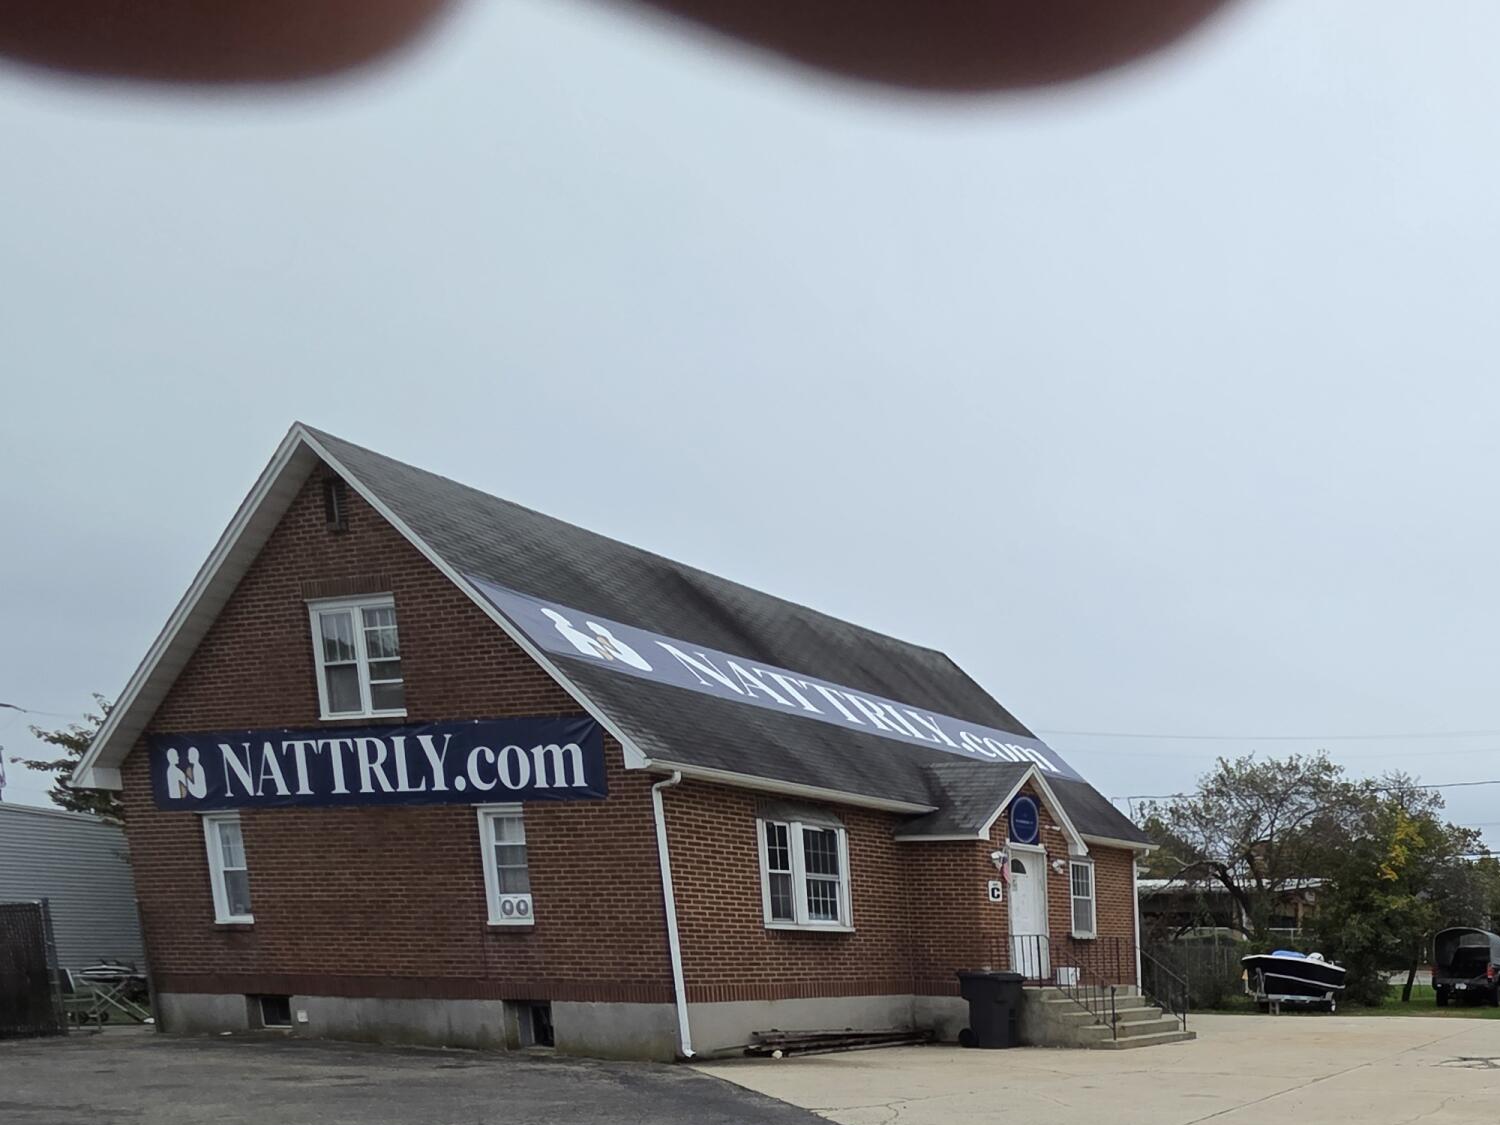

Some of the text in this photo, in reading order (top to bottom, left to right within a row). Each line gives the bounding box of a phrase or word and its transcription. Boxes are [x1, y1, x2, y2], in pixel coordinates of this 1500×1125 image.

[655, 640, 1062, 774] NATTRLY.com
[217, 732, 588, 798] NATTRLY.com
[991, 887, 1000, 899] C
